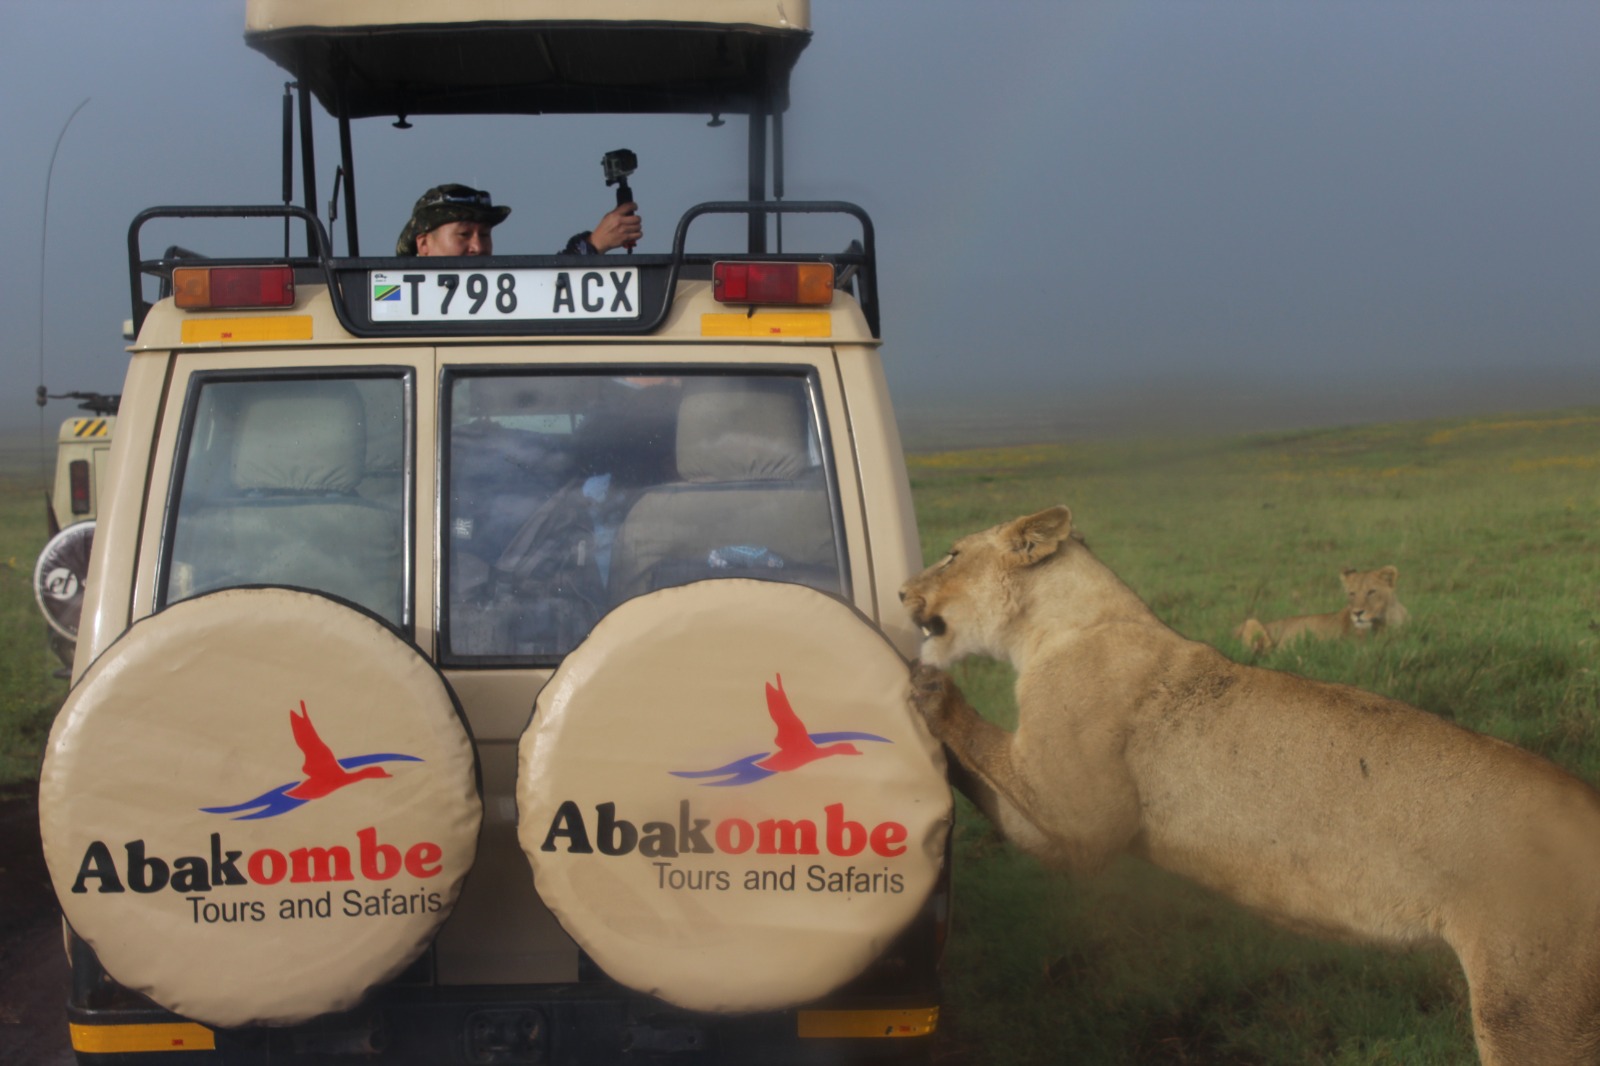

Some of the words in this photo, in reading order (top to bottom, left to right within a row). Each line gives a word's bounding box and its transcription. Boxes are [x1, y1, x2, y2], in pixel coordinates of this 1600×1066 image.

[553, 271, 633, 314] ACX
[541, 800, 908, 858] Abakombe
[72, 827, 443, 894] Abakombe
[653, 862, 730, 890] Tours
[744, 864, 796, 891] and
[806, 865, 905, 894] Safaris
[186, 896, 266, 923] Tours
[279, 891, 331, 919] and
[342, 887, 442, 917] Safaris
